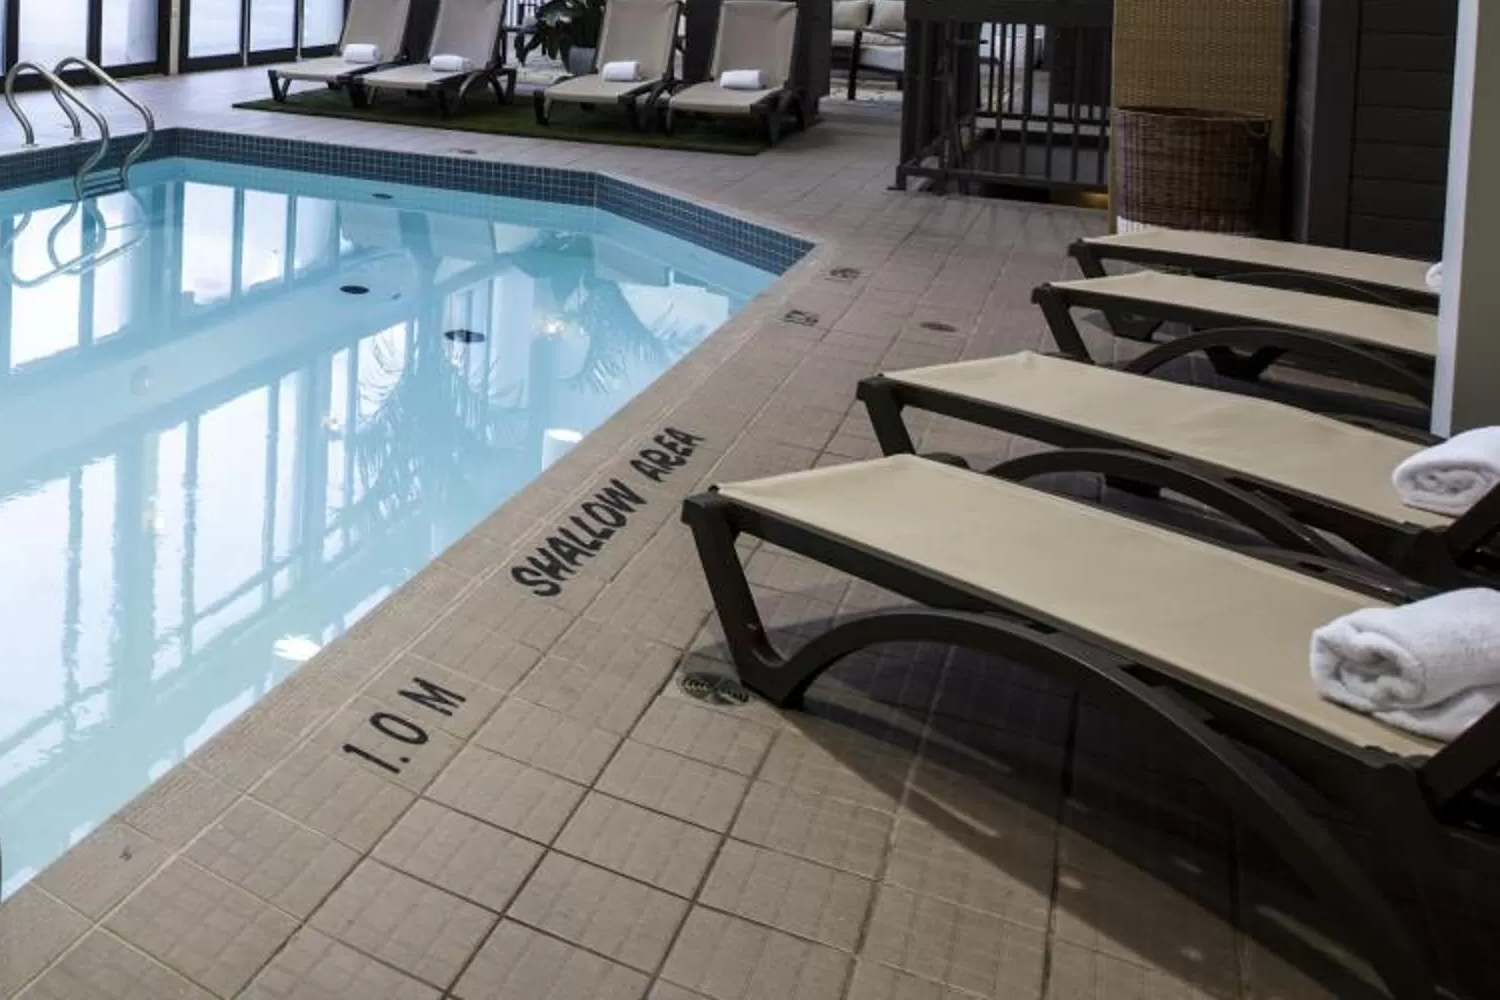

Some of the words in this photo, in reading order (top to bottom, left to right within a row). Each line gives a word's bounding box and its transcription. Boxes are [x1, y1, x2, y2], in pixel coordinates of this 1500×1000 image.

[511, 478, 647, 597] SHALLOW
[630, 426, 706, 483] AREA
[342, 712, 429, 774] 1.0
[397, 676, 467, 716] M
